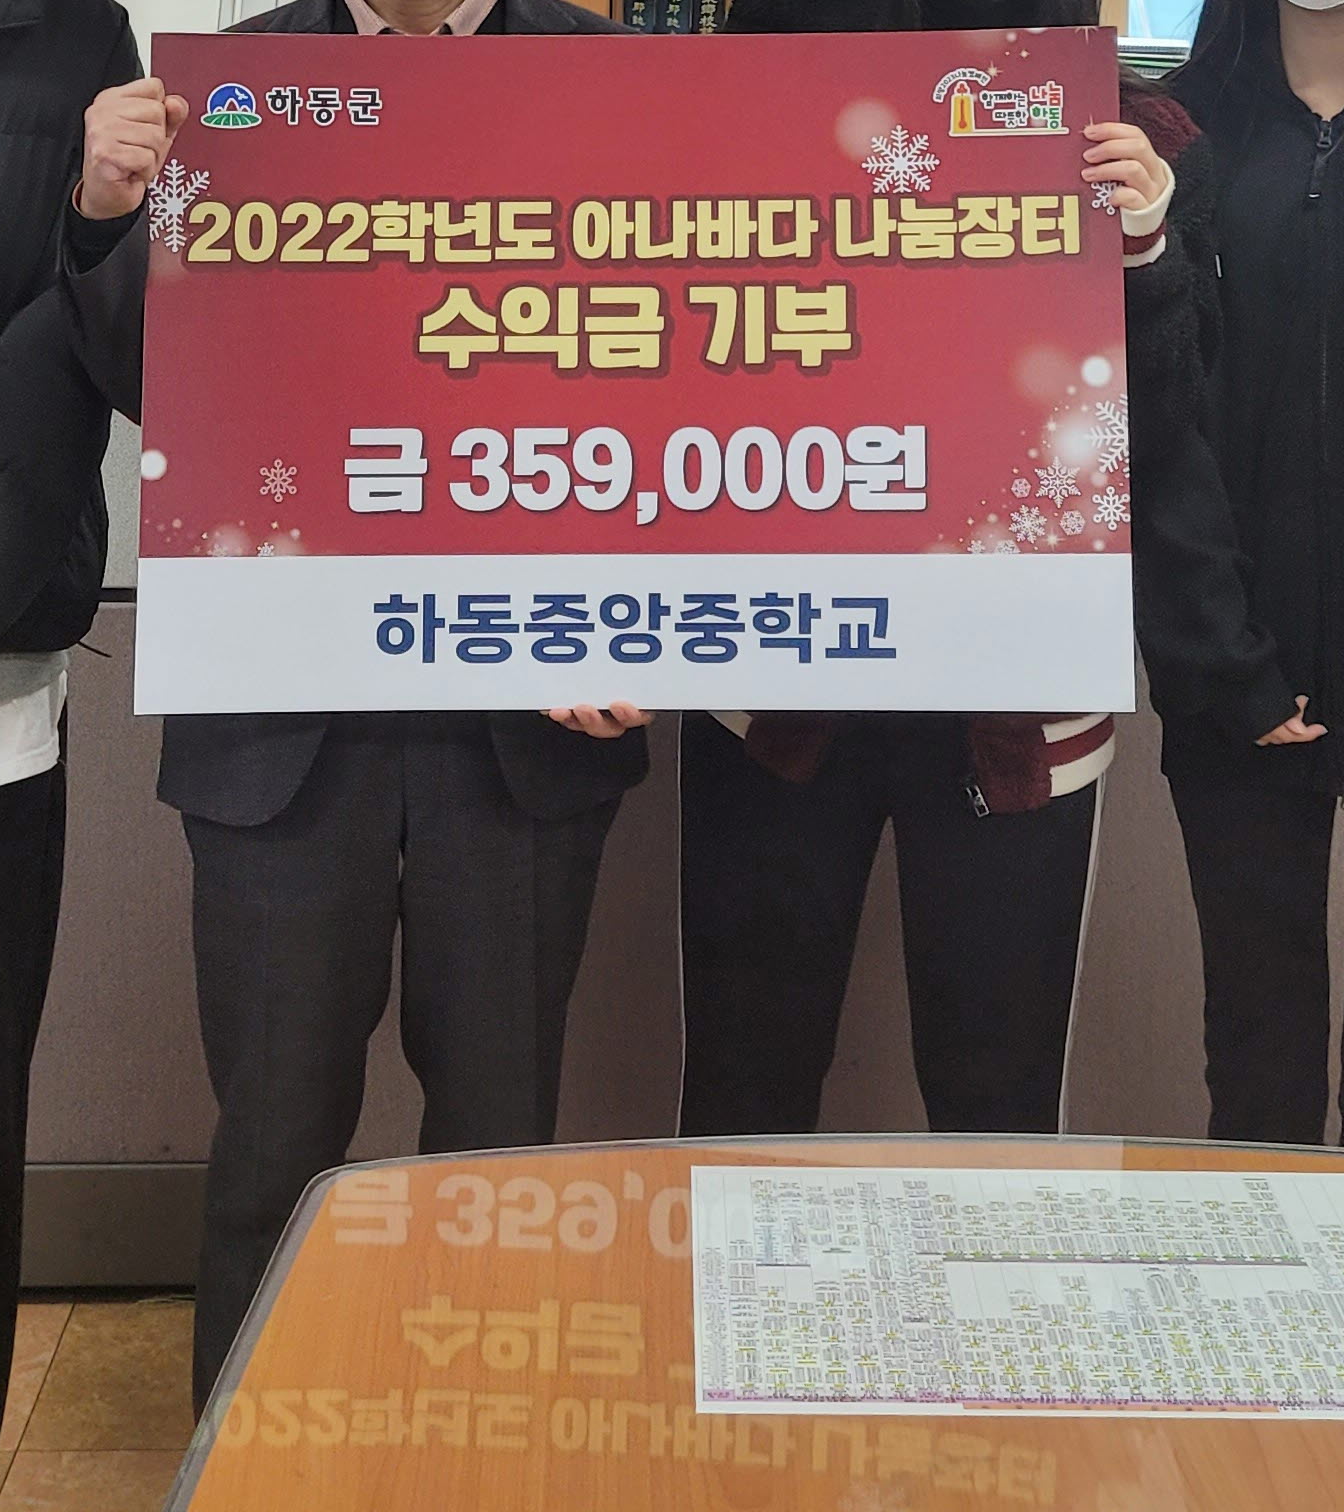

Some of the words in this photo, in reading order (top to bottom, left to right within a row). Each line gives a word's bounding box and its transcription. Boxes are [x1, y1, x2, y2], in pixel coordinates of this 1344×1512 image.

[266, 87, 382, 126] 하동군
[1030, 82, 1061, 106] 나눔
[1031, 106, 1060, 129] 하동
[187, 199, 555, 264] 2022학년도
[572, 198, 819, 260] 아나바다
[835, 194, 1080, 259] 나눔장터
[418, 285, 665, 370] 수익금
[688, 285, 853, 368] 기부
[344, 428, 428, 513] 금
[449, 425, 927, 525] 359,000원
[373, 592, 897, 664] 하동중앙중학교
